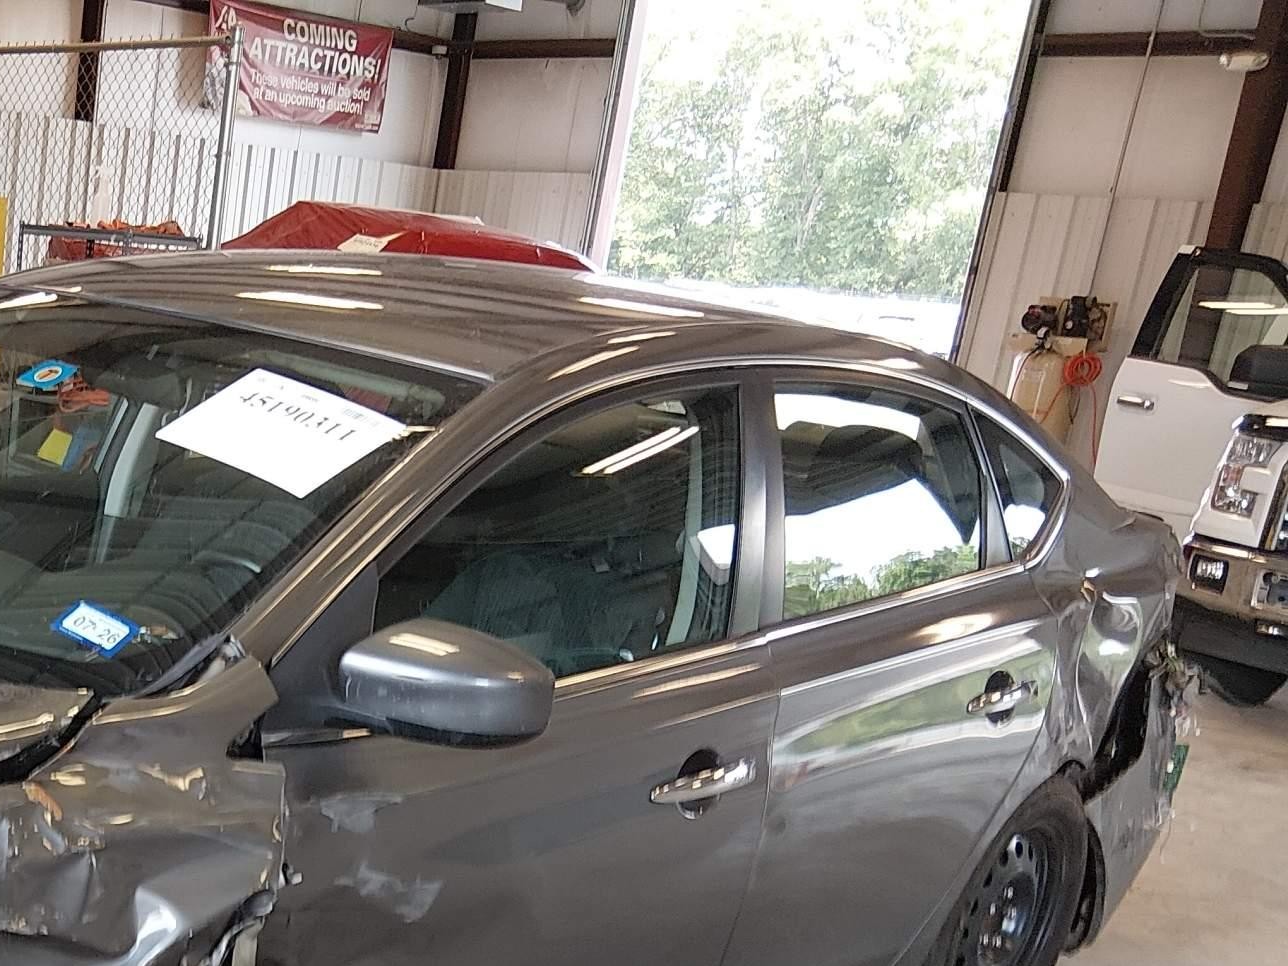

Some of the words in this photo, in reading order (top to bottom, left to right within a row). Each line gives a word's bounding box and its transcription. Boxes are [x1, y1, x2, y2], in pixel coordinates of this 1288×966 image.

[283, 18, 358, 52] COMING
[248, 36, 382, 84] ATTRACTIONS!
[250, 69, 279, 88] These
[279, 74, 320, 95] vehicles
[320, 82, 337, 97] will
[338, 83, 351, 98] be
[352, 86, 372, 102] sold
[252, 85, 264, 99] at
[264, 90, 279, 102] an
[279, 92, 327, 113] upcoming
[327, 99, 364, 115] auction!
[239, 392, 357, 441] 45190311
